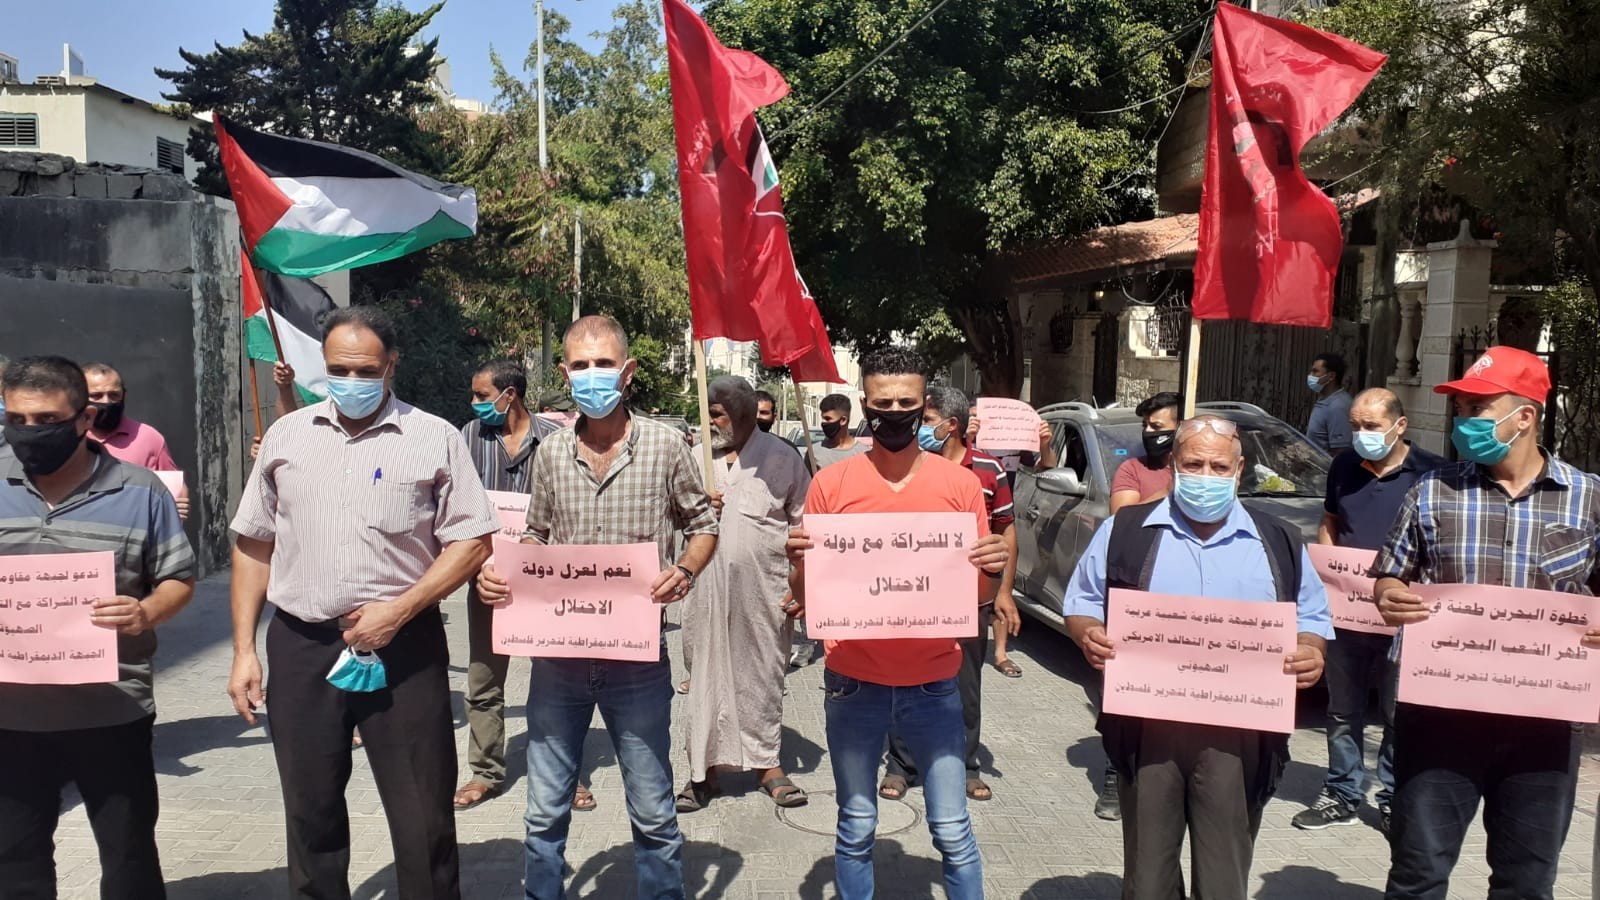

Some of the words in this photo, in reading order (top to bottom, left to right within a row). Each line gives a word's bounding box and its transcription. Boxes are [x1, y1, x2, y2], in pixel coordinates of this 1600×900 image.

[824, 533, 856, 553] دولة
[862, 537, 884, 554] مع
[890, 532, 948, 552] للشراكة
[954, 532, 963, 548] لا
[522, 562, 554, 578] دولة
[560, 563, 597, 580] لعزل
[603, 562, 632, 581] نعم
[1328, 558, 1348, 574] دولة
[36, 570, 68, 582] لجبهة
[73, 568, 98, 582] ندعو
[869, 576, 930, 596] الاحتلال
[16, 600, 31, 610] مع
[36, 596, 78, 609] الشراكة
[554, 598, 612, 617] الاحتلال
[1446, 599, 1484, 616] طعنة
[1190, 612, 1224, 625] مقاومة
[1490, 608, 1544, 623] البحرين
[1549, 608, 1588, 626] خطوة
[1167, 634, 1204, 647] التحالف
[1208, 640, 1222, 651] مع
[1226, 638, 1262, 654] الشراكة
[1431, 636, 1496, 652] البحريني
[1501, 642, 1550, 657] الشعب
